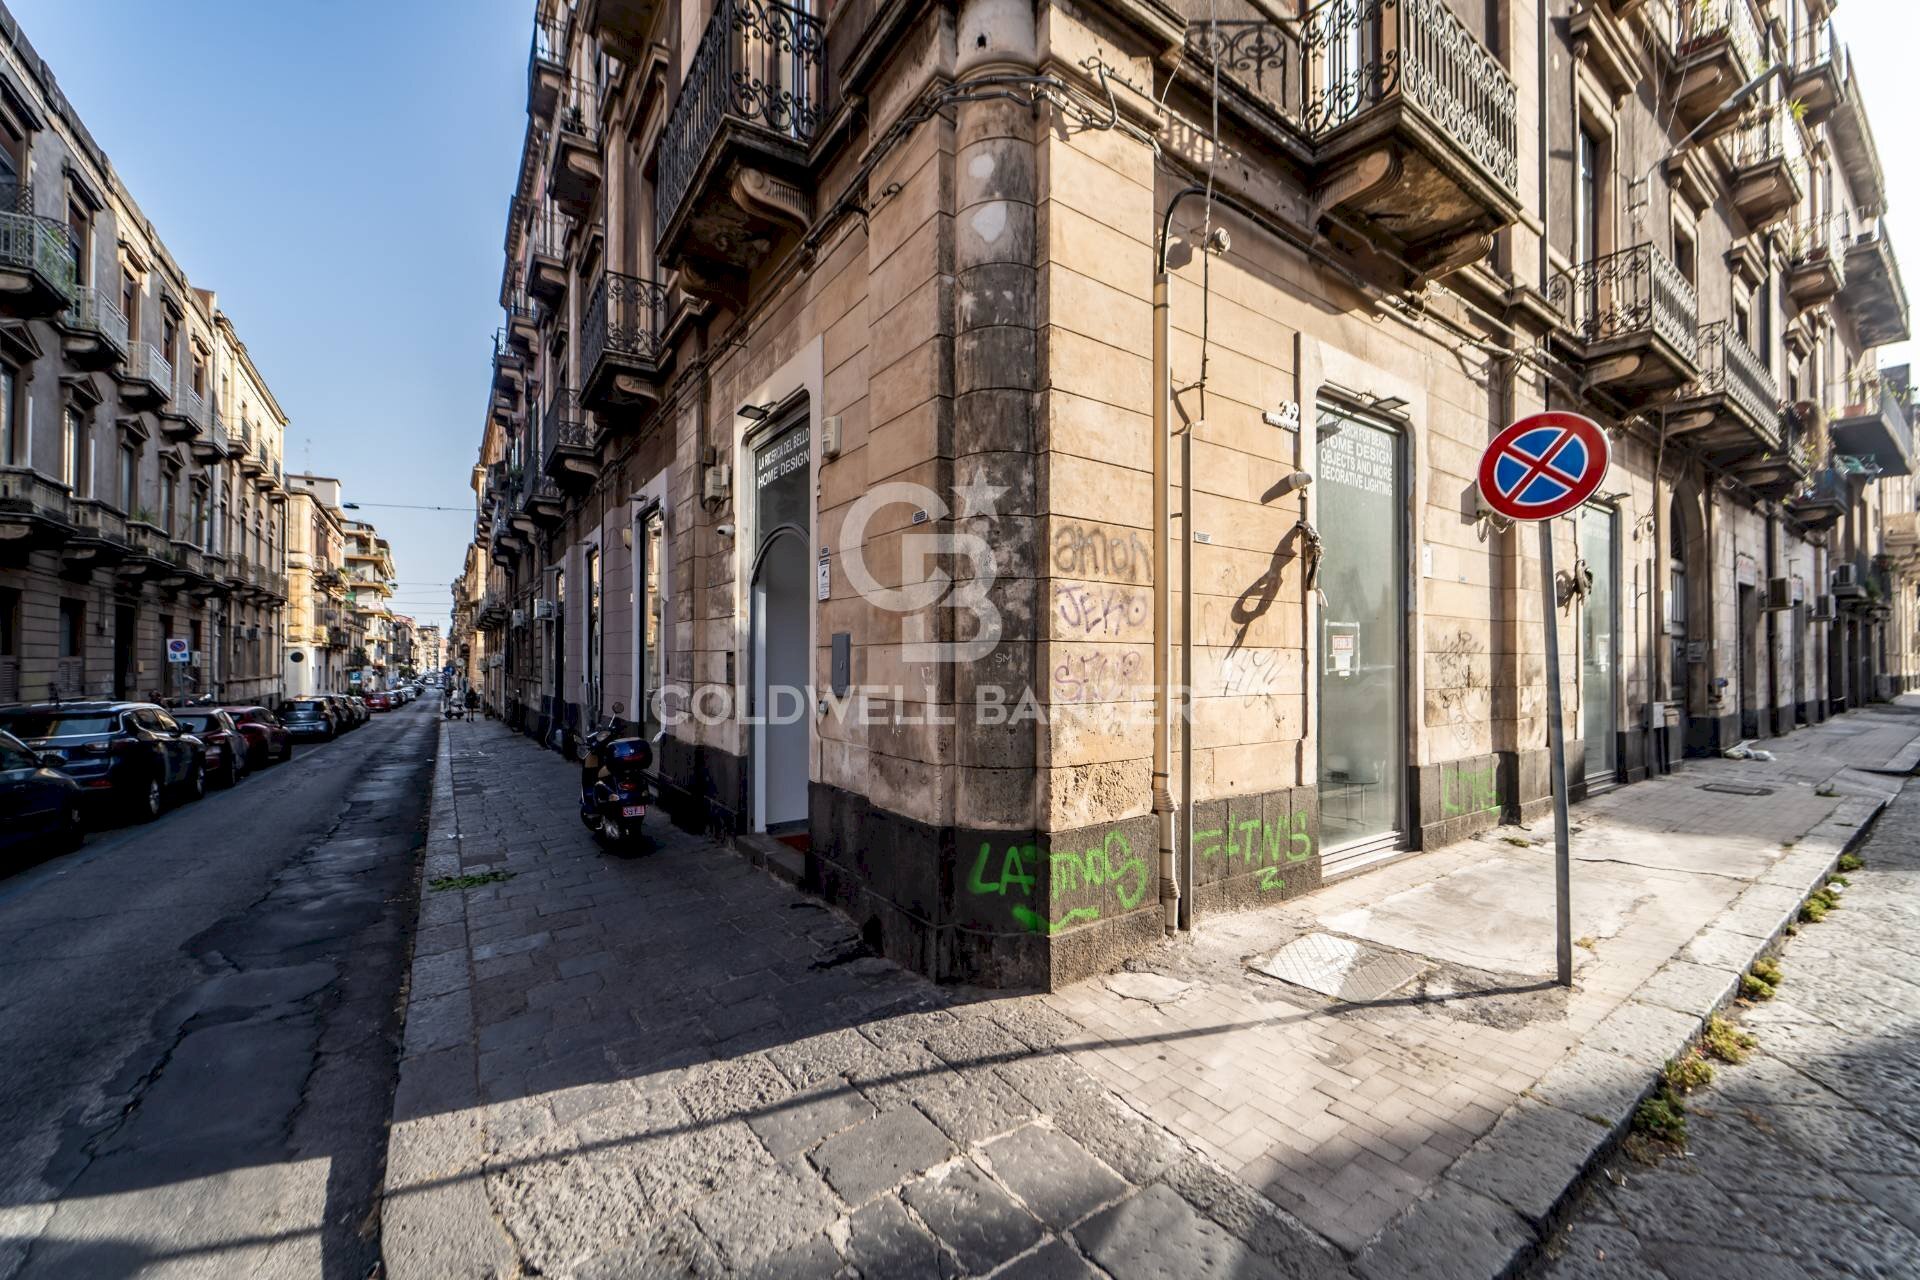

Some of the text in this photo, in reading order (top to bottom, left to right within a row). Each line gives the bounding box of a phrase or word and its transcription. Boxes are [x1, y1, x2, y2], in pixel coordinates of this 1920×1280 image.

[758, 427, 810, 471] LA RICERCA DEL BELLO
[1321, 433, 1392, 465] HOME DESIGN
[1359, 427, 1371, 444] FOR
[758, 448, 810, 490] HOME DESIGN
[1321, 448, 1392, 481] OBJECTS AND MORE
[1321, 463, 1392, 496] DECORATIVE LIGHTING
